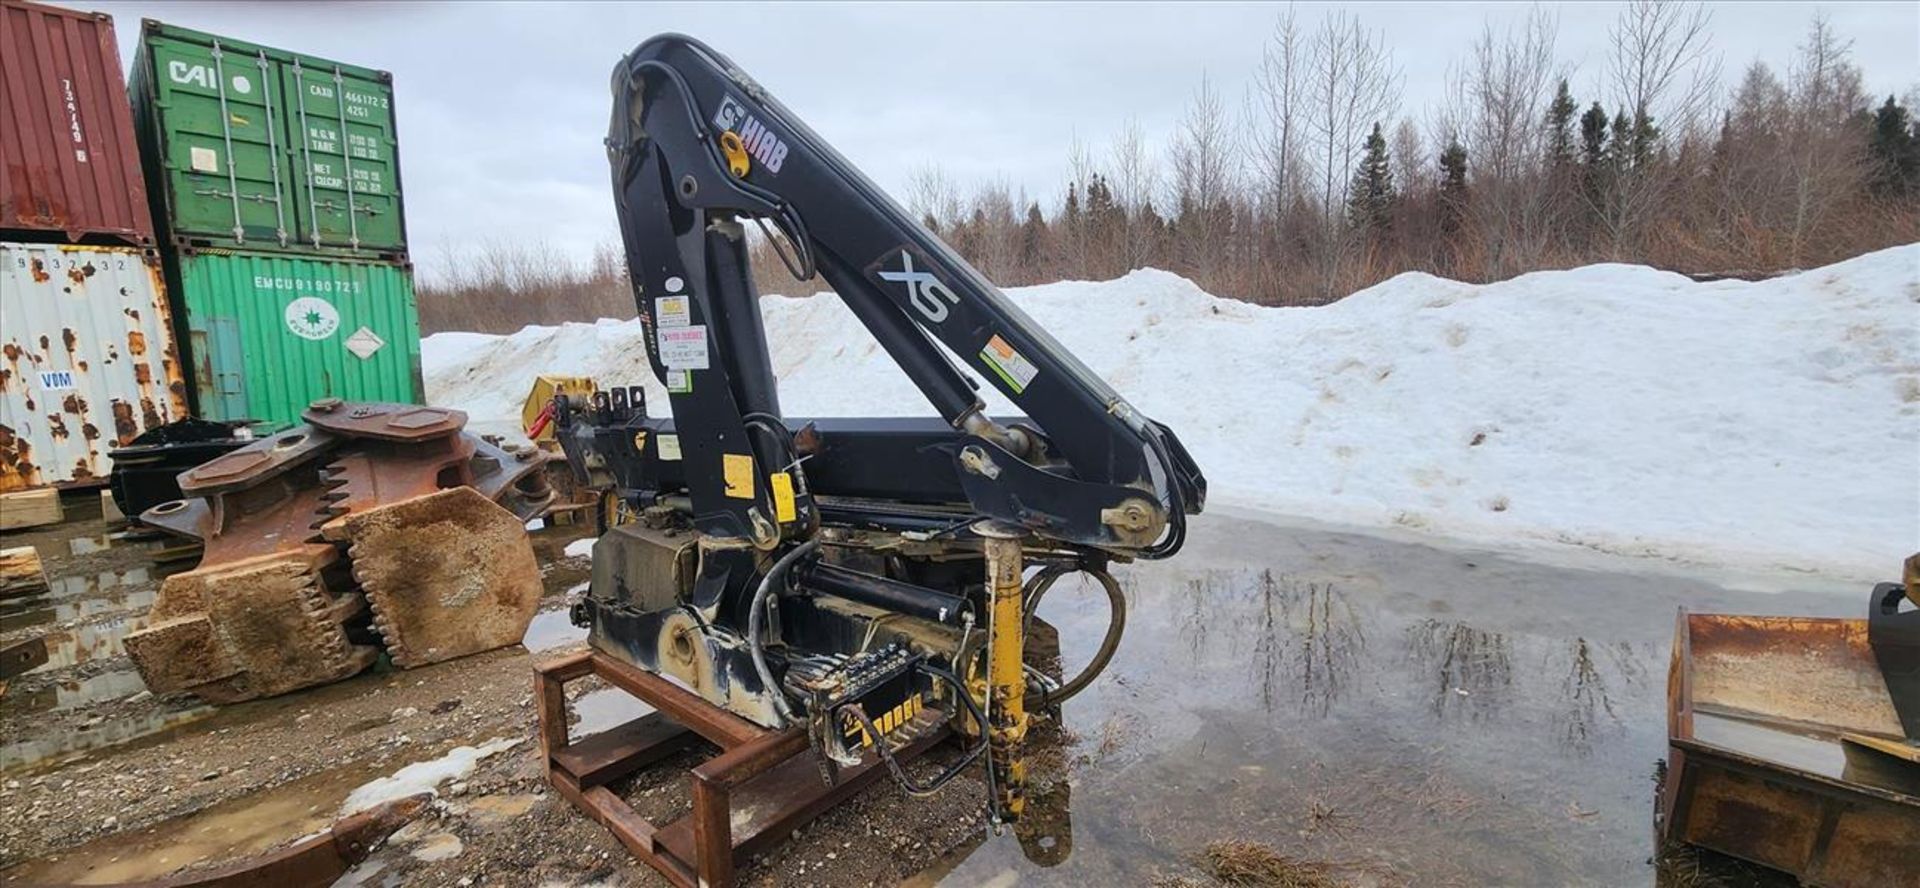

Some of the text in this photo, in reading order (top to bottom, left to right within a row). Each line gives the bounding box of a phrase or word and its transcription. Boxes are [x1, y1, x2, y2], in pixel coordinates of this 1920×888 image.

[169, 60, 217, 89] CAI
[741, 114, 789, 174] HIAB
[877, 249, 960, 323] XS
[42, 371, 72, 388] VOM
